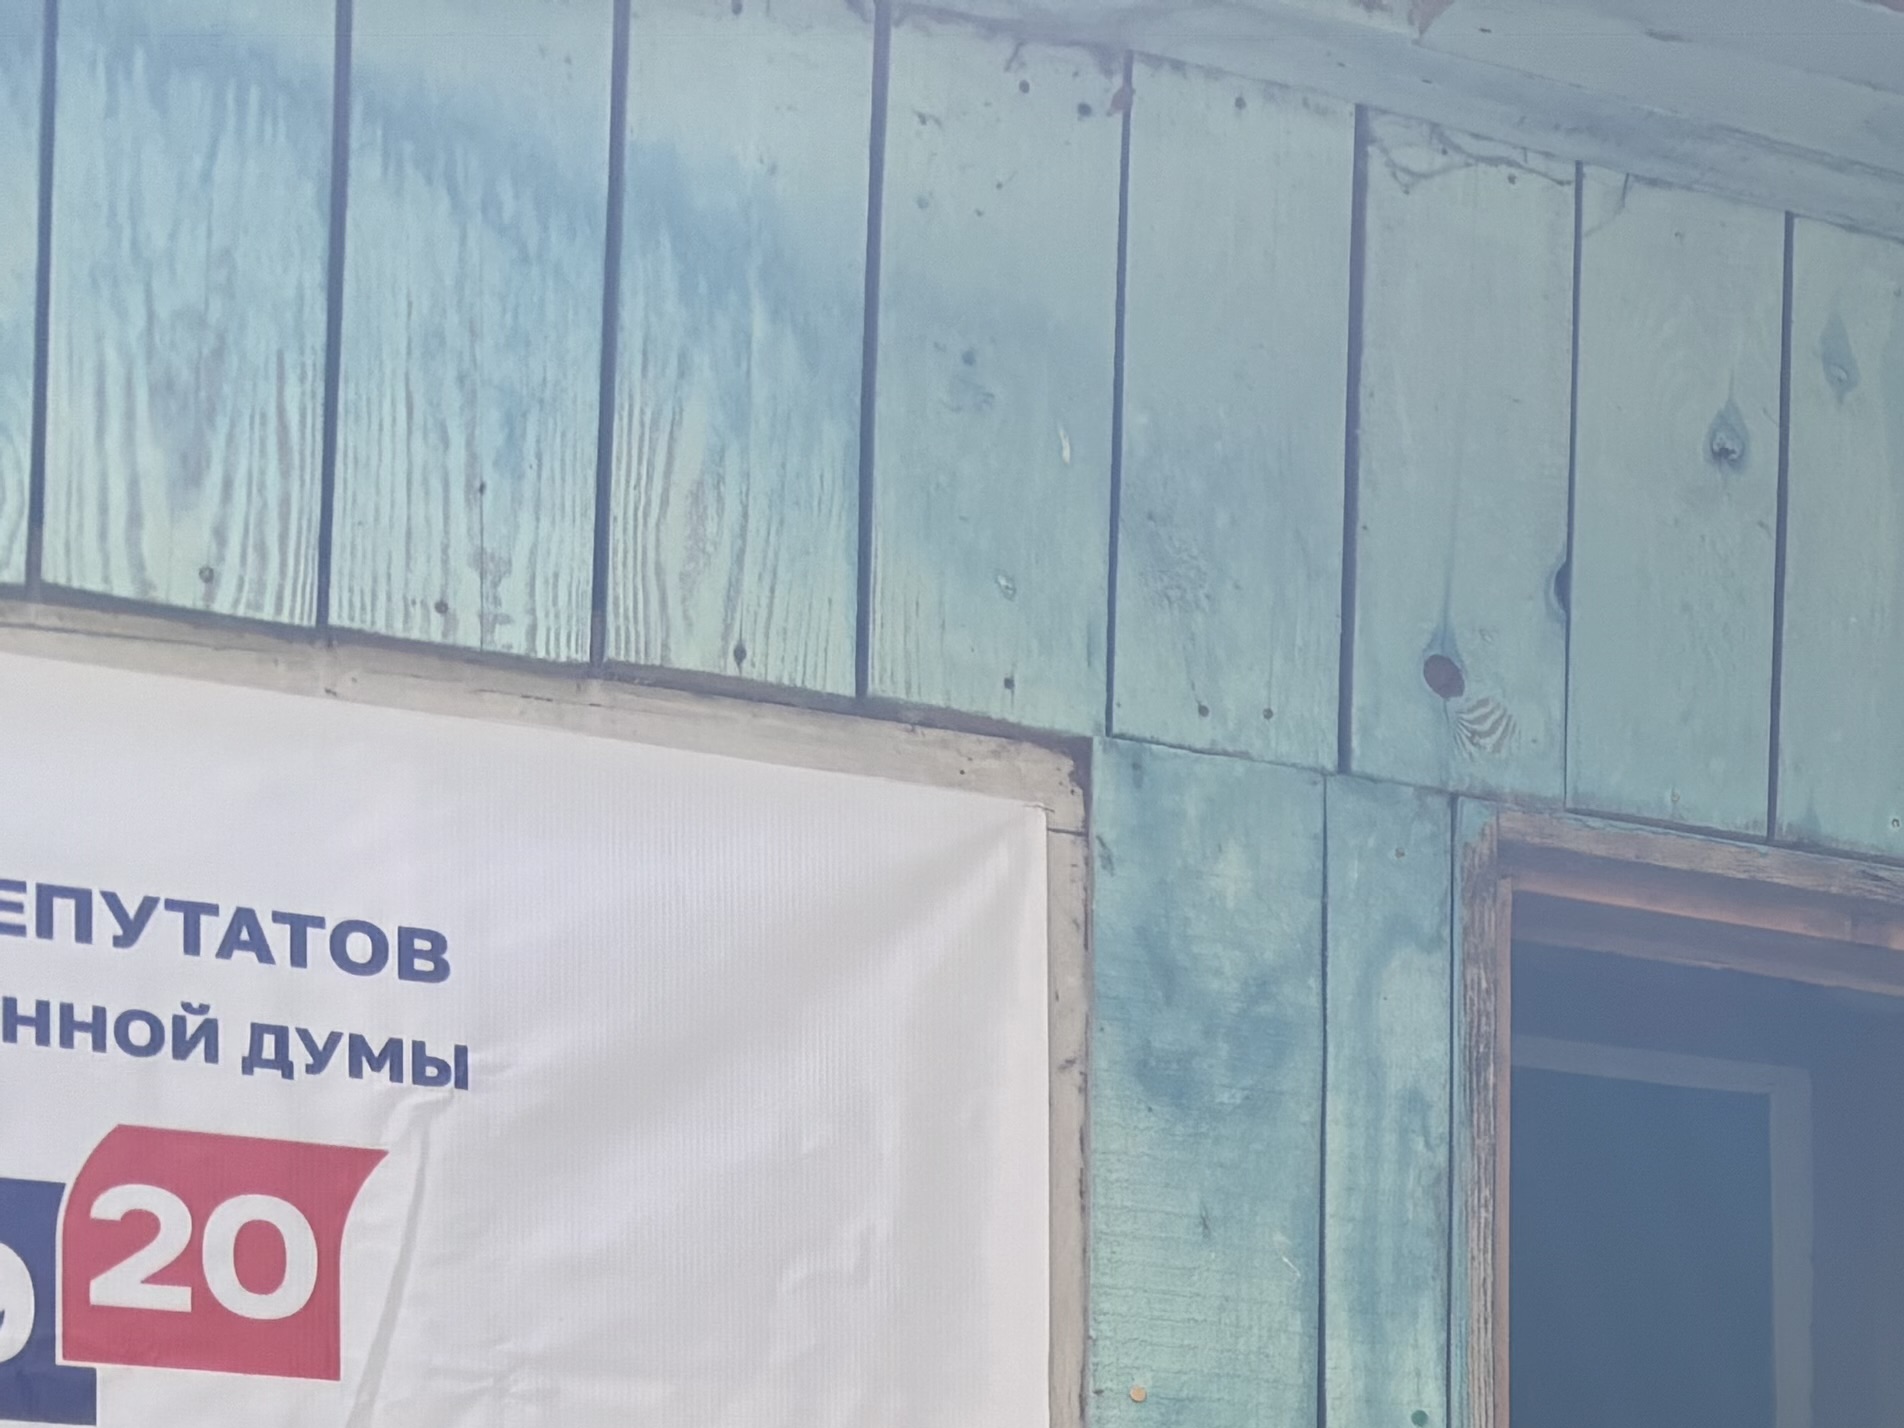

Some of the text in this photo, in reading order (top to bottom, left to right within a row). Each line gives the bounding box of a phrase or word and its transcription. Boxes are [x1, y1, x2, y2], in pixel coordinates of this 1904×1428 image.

[2, 996, 469, 1091] ННОЙ ДУМЫ
[89, 1183, 319, 1321] 20
